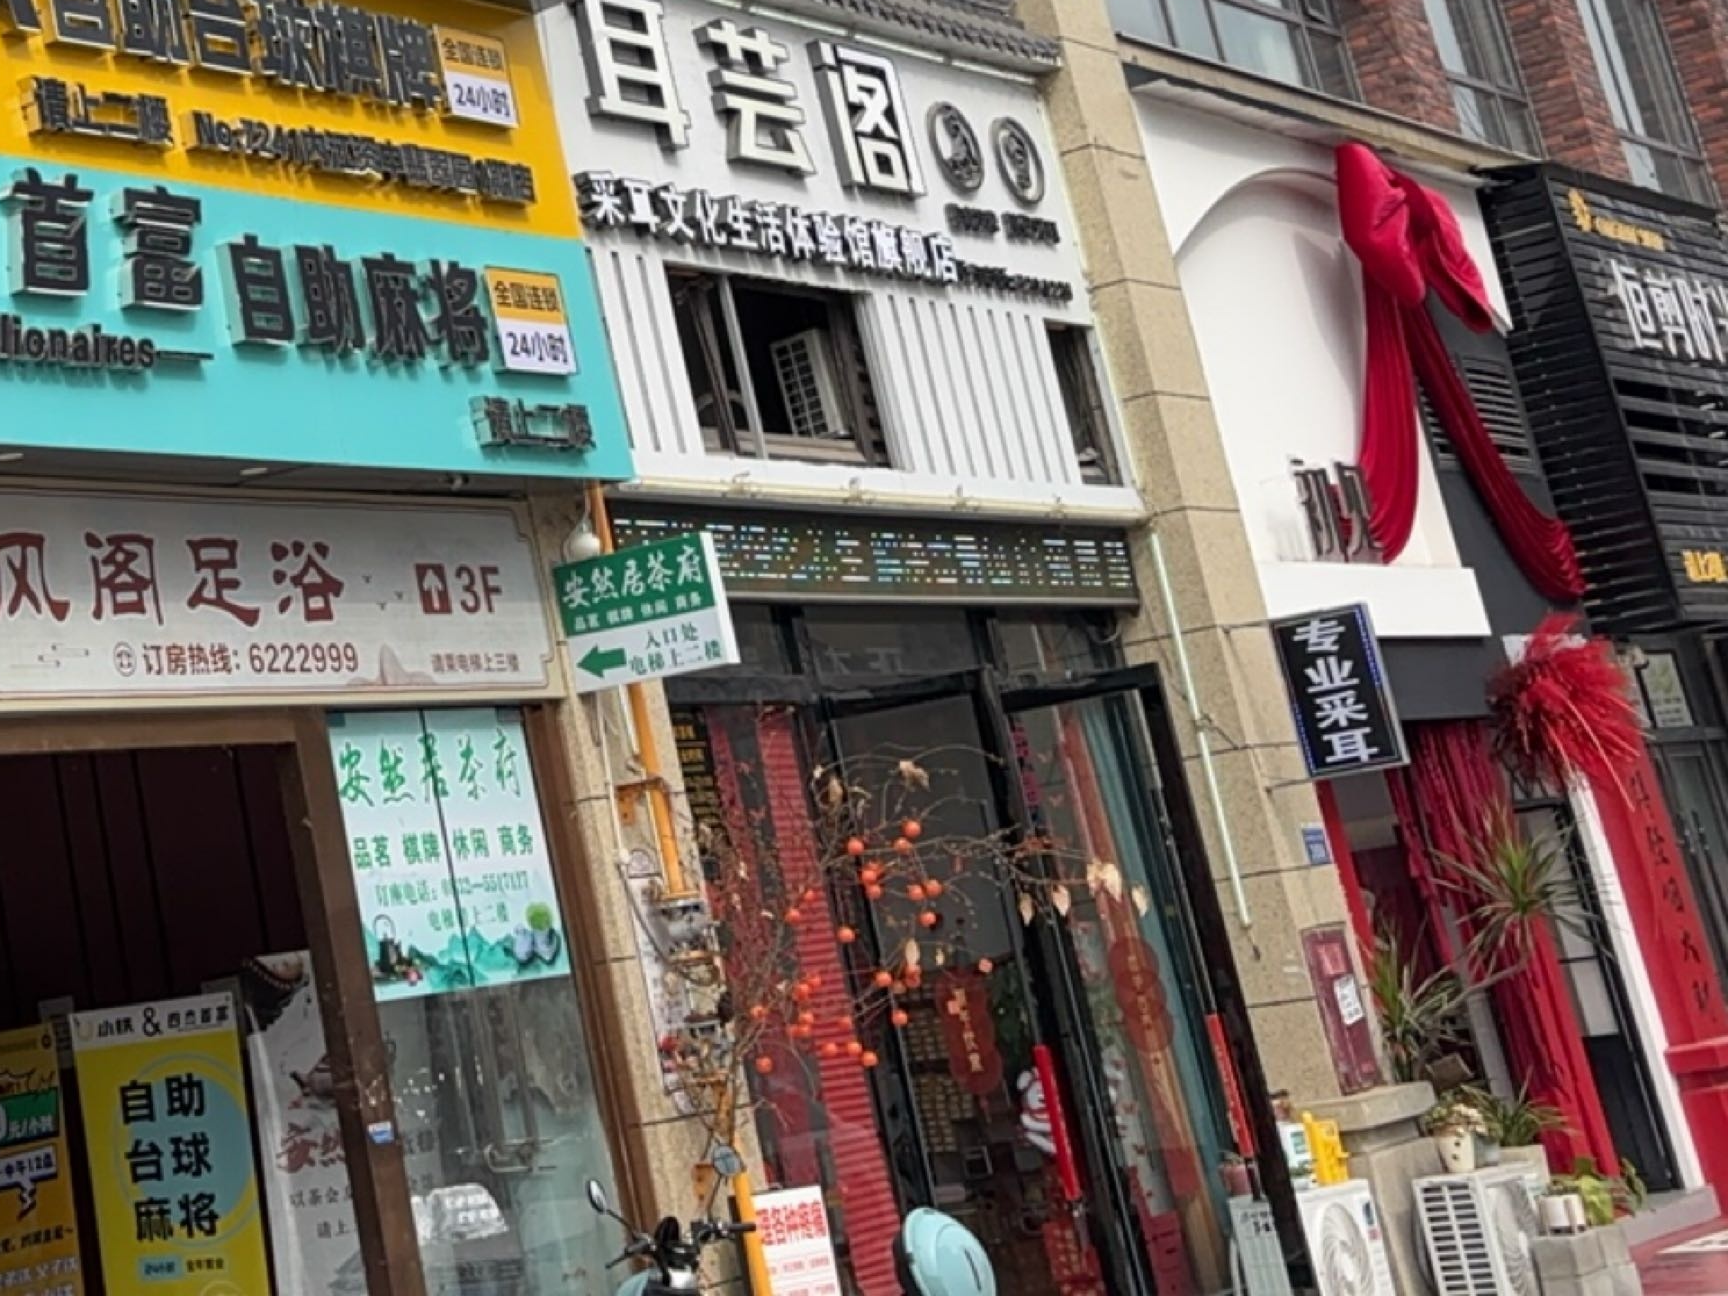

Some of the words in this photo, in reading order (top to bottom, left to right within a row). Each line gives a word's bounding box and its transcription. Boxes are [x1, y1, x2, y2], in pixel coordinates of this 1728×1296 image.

[451, 82, 512, 120] 24小时
[575, 171, 960, 285] 采耳文化生活体验馆旗舰店
[219, 232, 491, 367] 自助麻将
[505, 329, 570, 366] 24小时
[455, 564, 504, 615] 3F
[562, 545, 705, 610] 安然居茶府
[249, 641, 360, 674] 6222999
[629, 638, 723, 676] 电梯上二楼
[645, 619, 700, 650] 入口处
[1291, 617, 1381, 765] 专业采耳
[119, 1072, 207, 1127] 自助
[125, 1132, 213, 1184] 台球
[134, 1192, 221, 1244] 麻将
[315, 1219, 359, 1240] 请上
